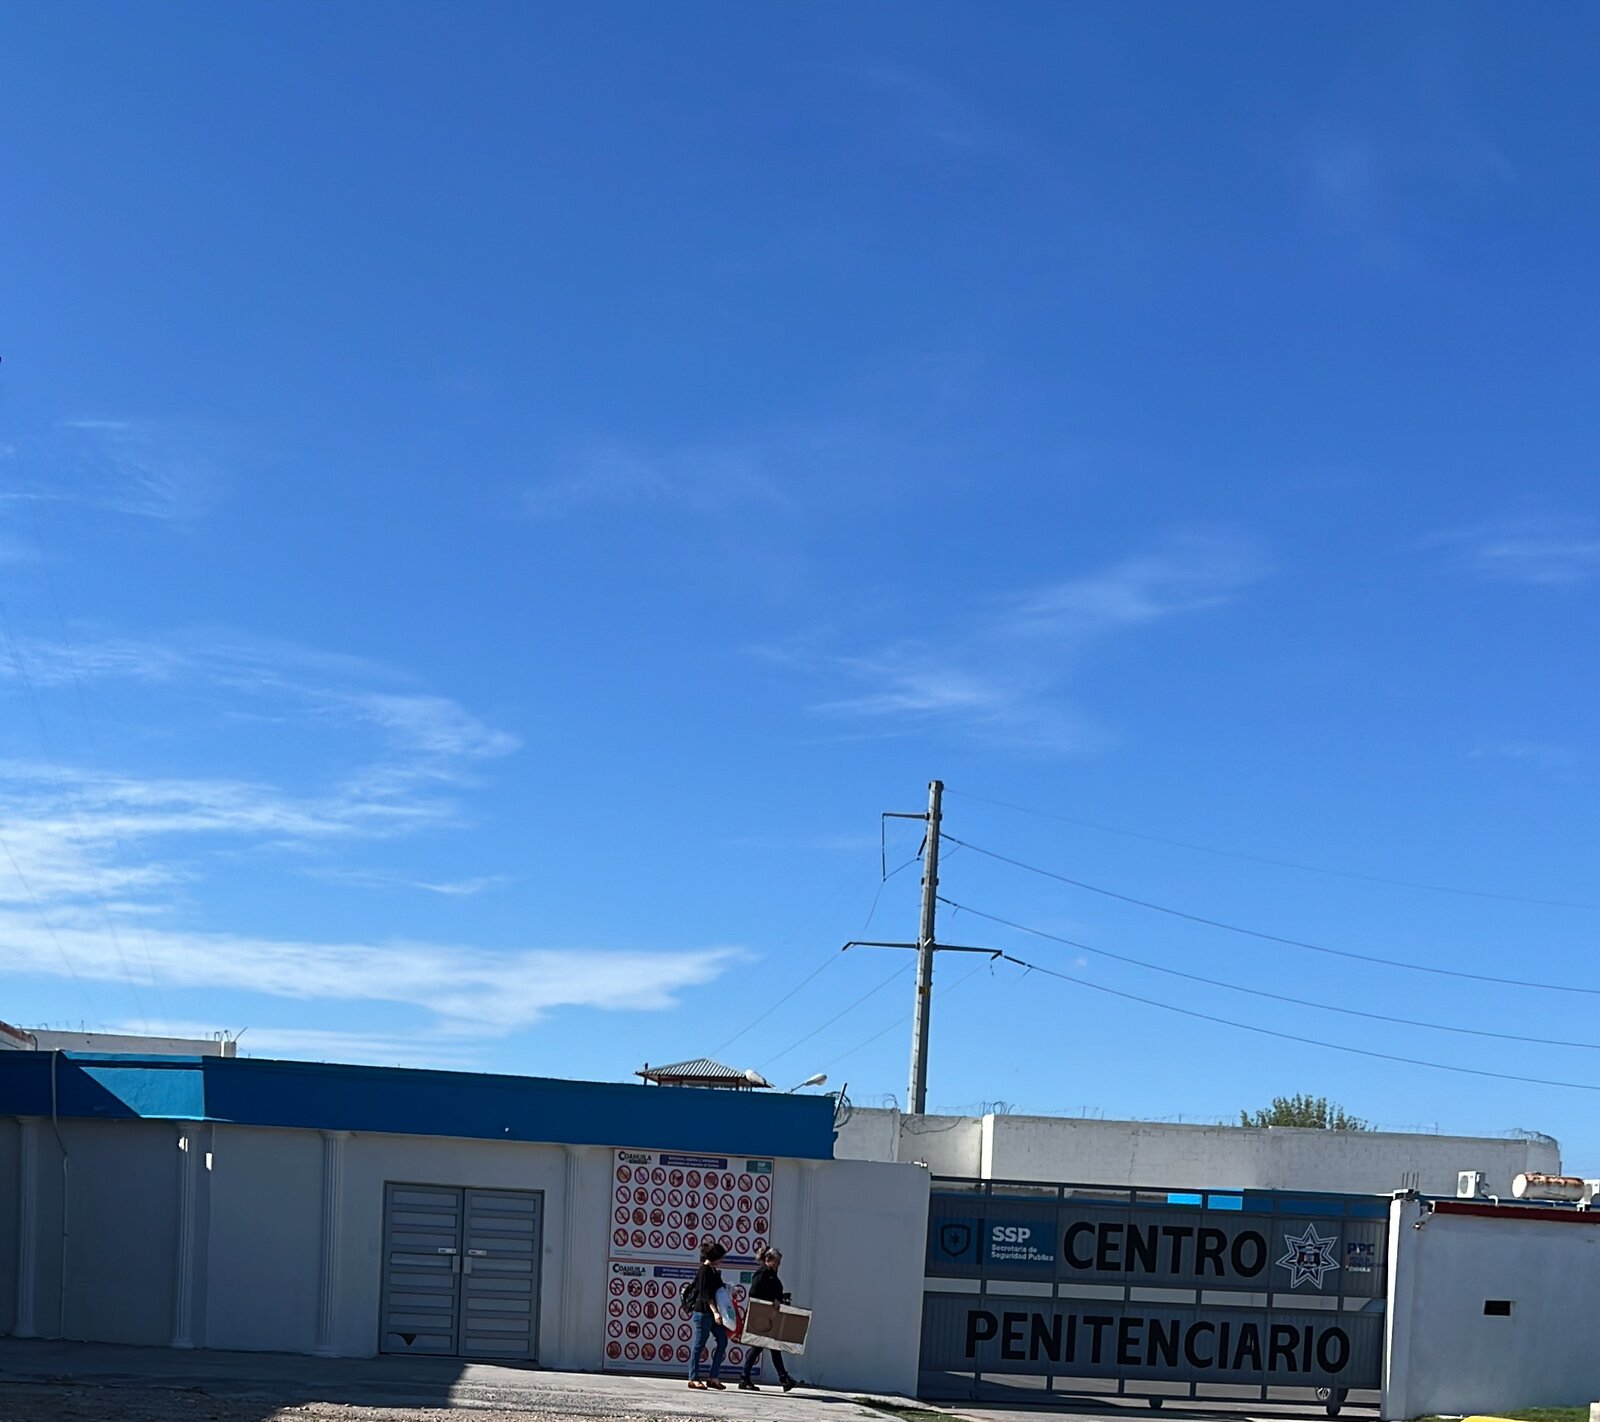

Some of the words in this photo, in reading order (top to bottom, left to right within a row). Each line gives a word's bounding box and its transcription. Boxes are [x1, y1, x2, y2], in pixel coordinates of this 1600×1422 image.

[991, 1226, 1031, 1243] SSP
[1064, 1222, 1267, 1277] CENTRO
[991, 1251, 1027, 1260] Seguridad
[964, 1309, 1351, 1374] PENITENCIARIO
